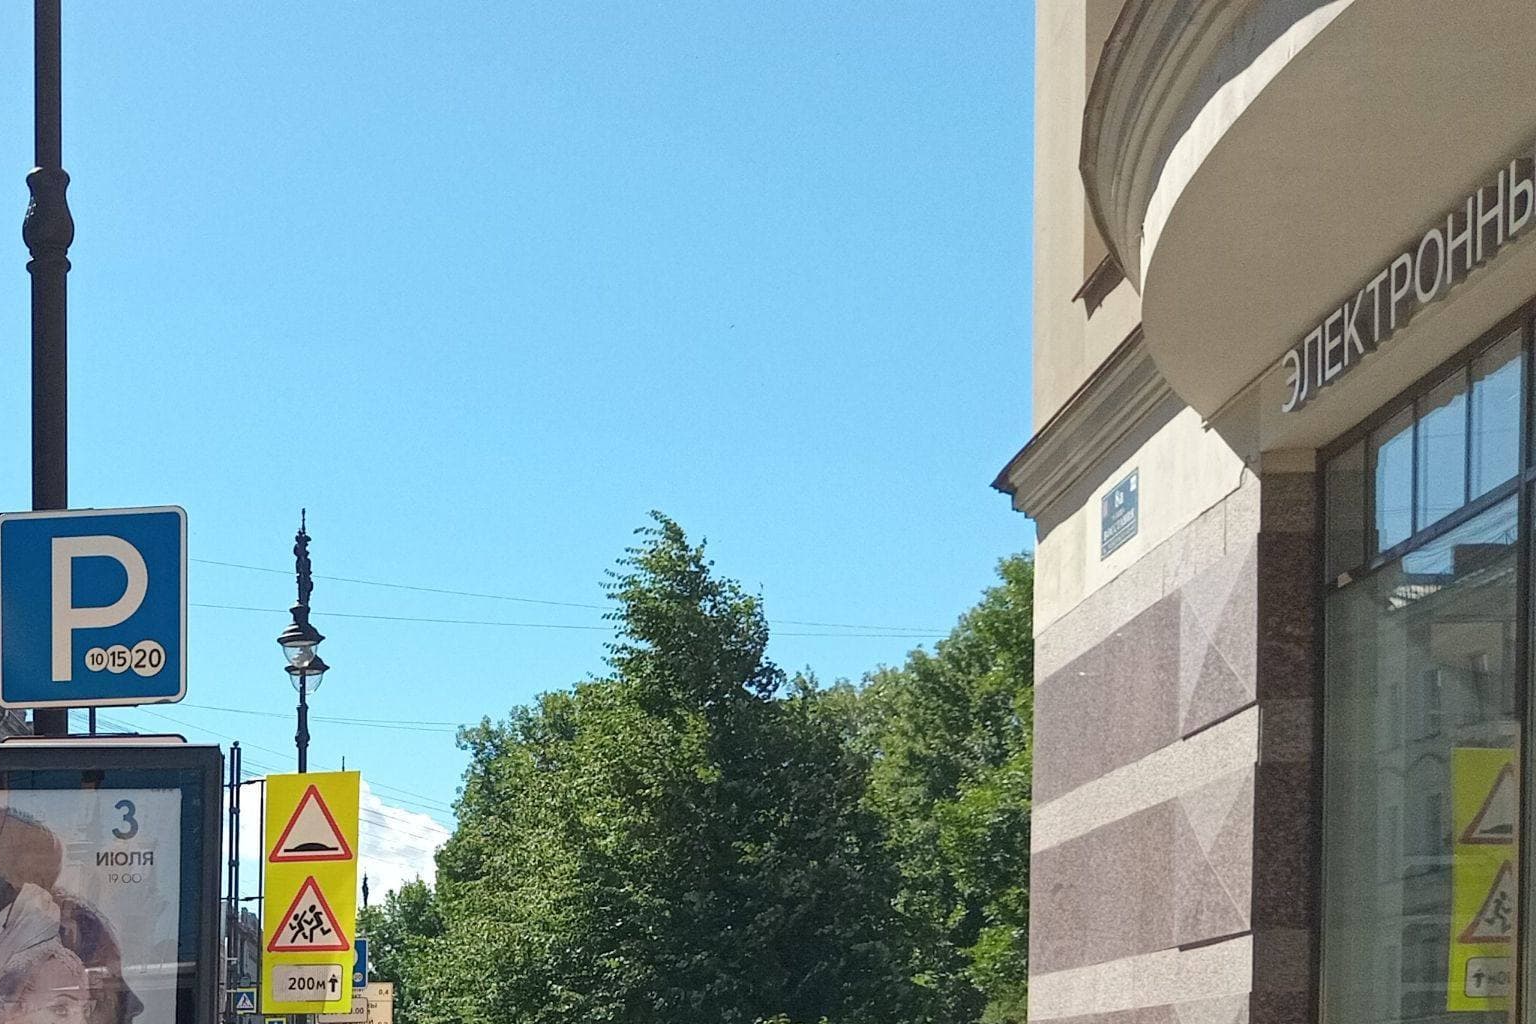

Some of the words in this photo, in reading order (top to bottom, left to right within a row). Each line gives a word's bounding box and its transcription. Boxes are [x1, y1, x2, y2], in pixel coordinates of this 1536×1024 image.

[52, 535, 148, 681] P
[90, 653, 104, 666] 10
[110, 651, 127, 667] 15
[134, 649, 161, 668] 20
[112, 799, 139, 840] 3
[96, 851, 154, 866] ИЮЛЯ
[288, 976, 327, 991] 200м
